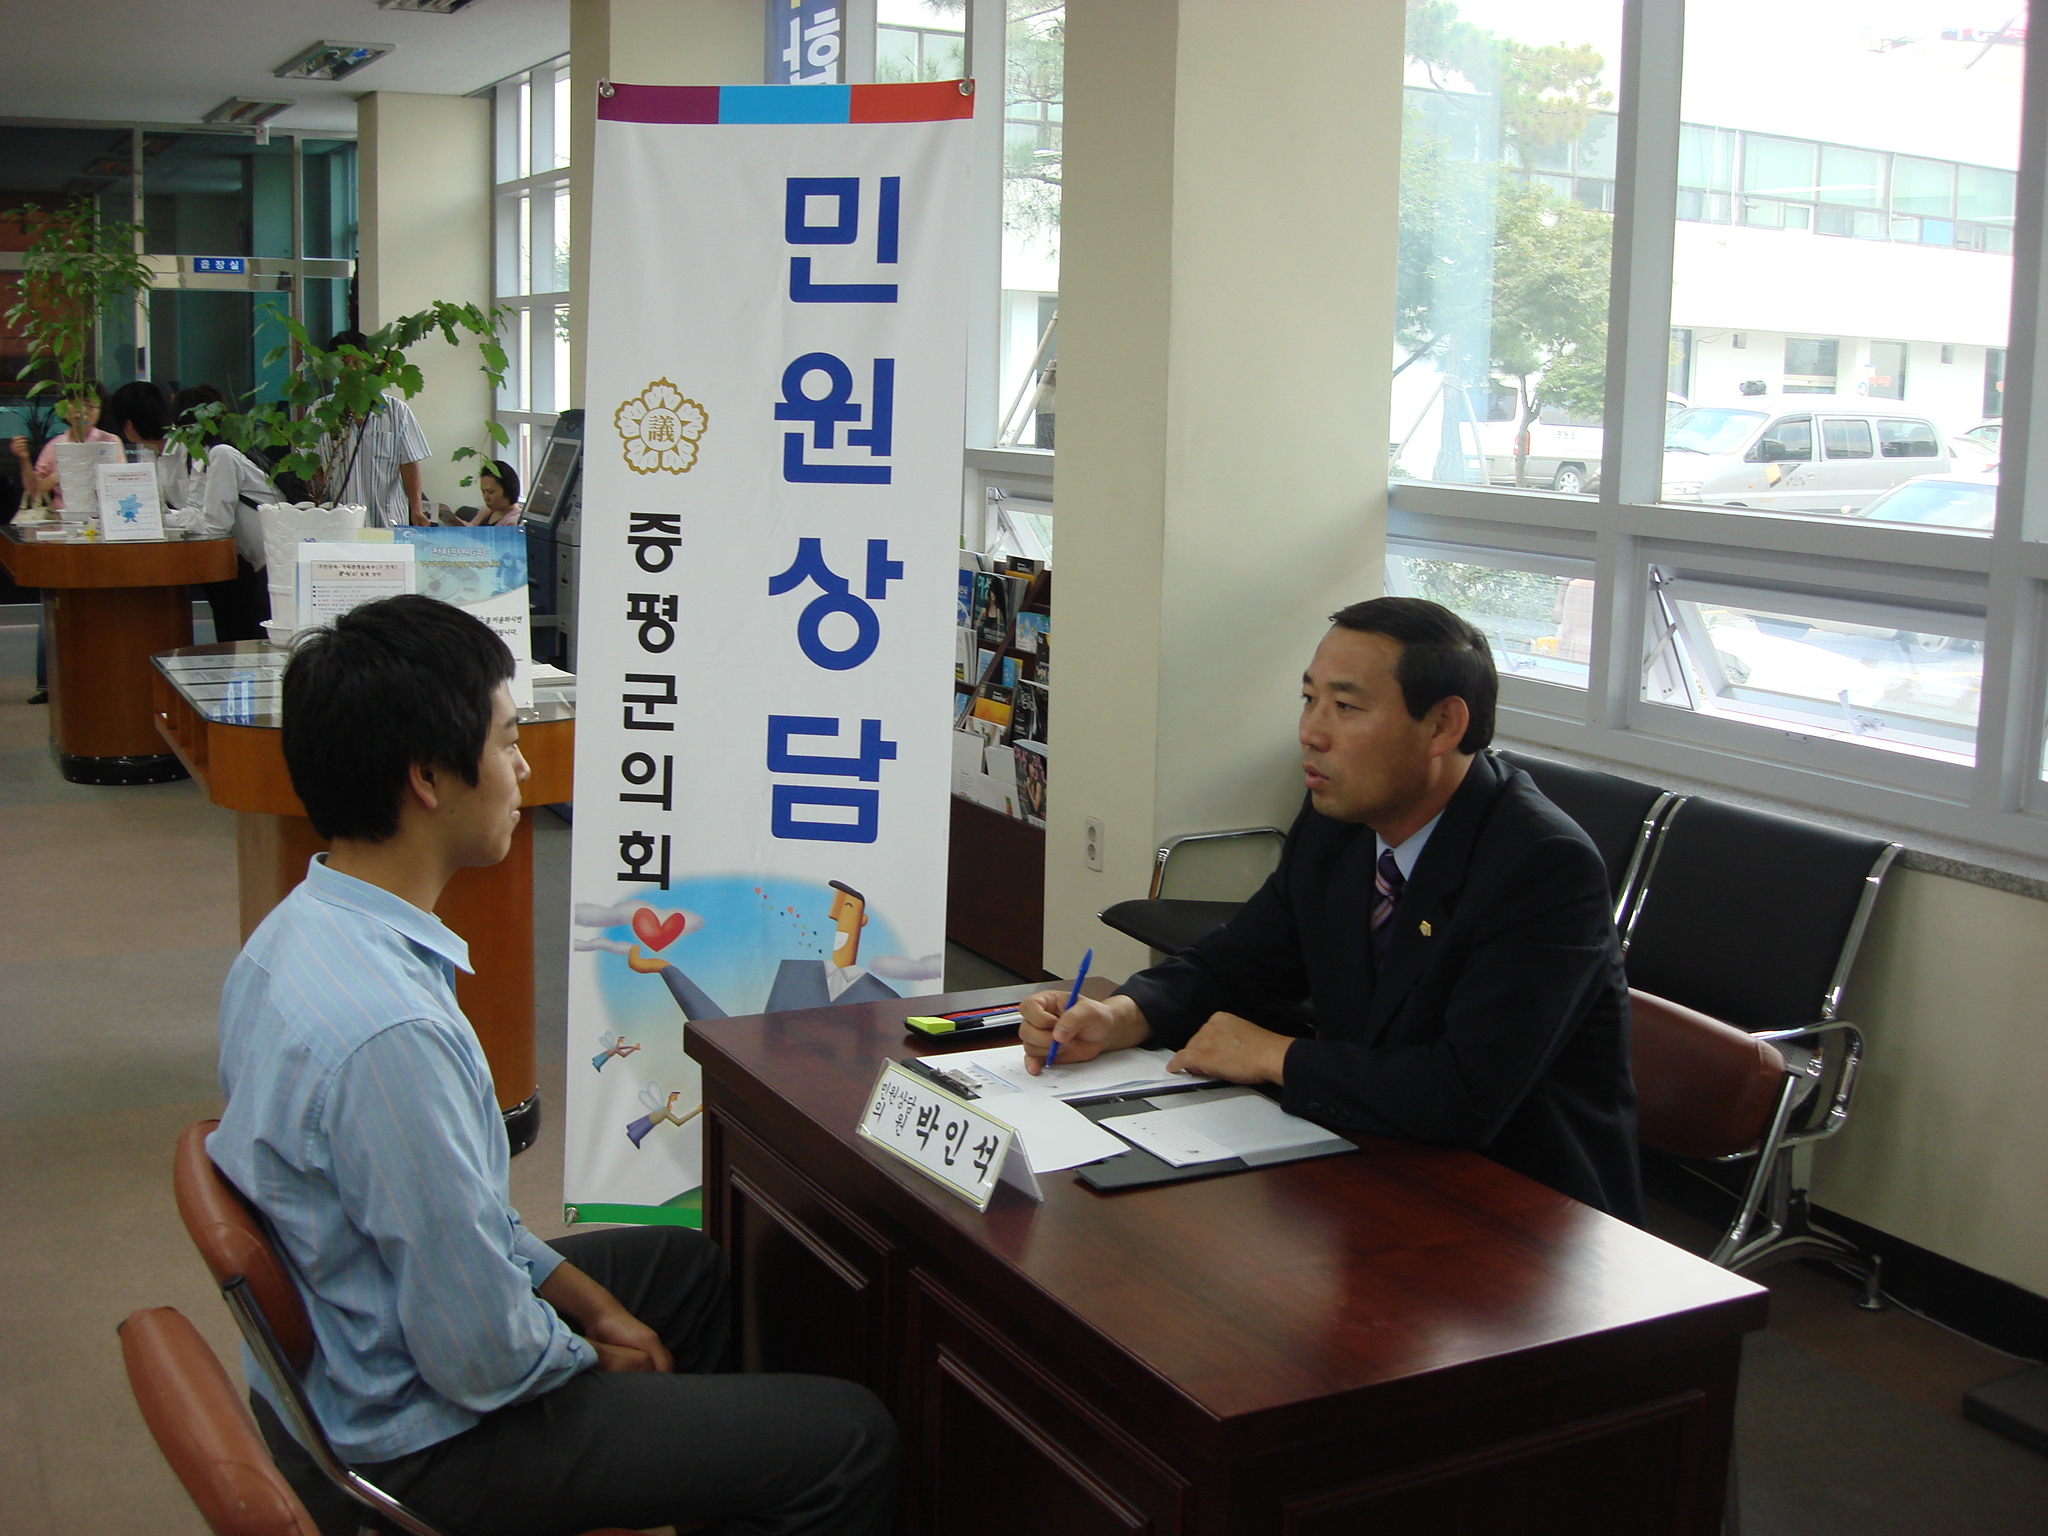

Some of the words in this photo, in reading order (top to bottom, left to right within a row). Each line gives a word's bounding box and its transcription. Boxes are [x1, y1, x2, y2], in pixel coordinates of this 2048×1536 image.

[200, 259, 240, 271] 읍장실
[648, 414, 675, 443] 議
[768, 176, 904, 844] 민원상담
[617, 512, 682, 891] 증평군의회
[880, 1081, 917, 1116] 민원상담
[916, 1103, 999, 1184] 박인석
